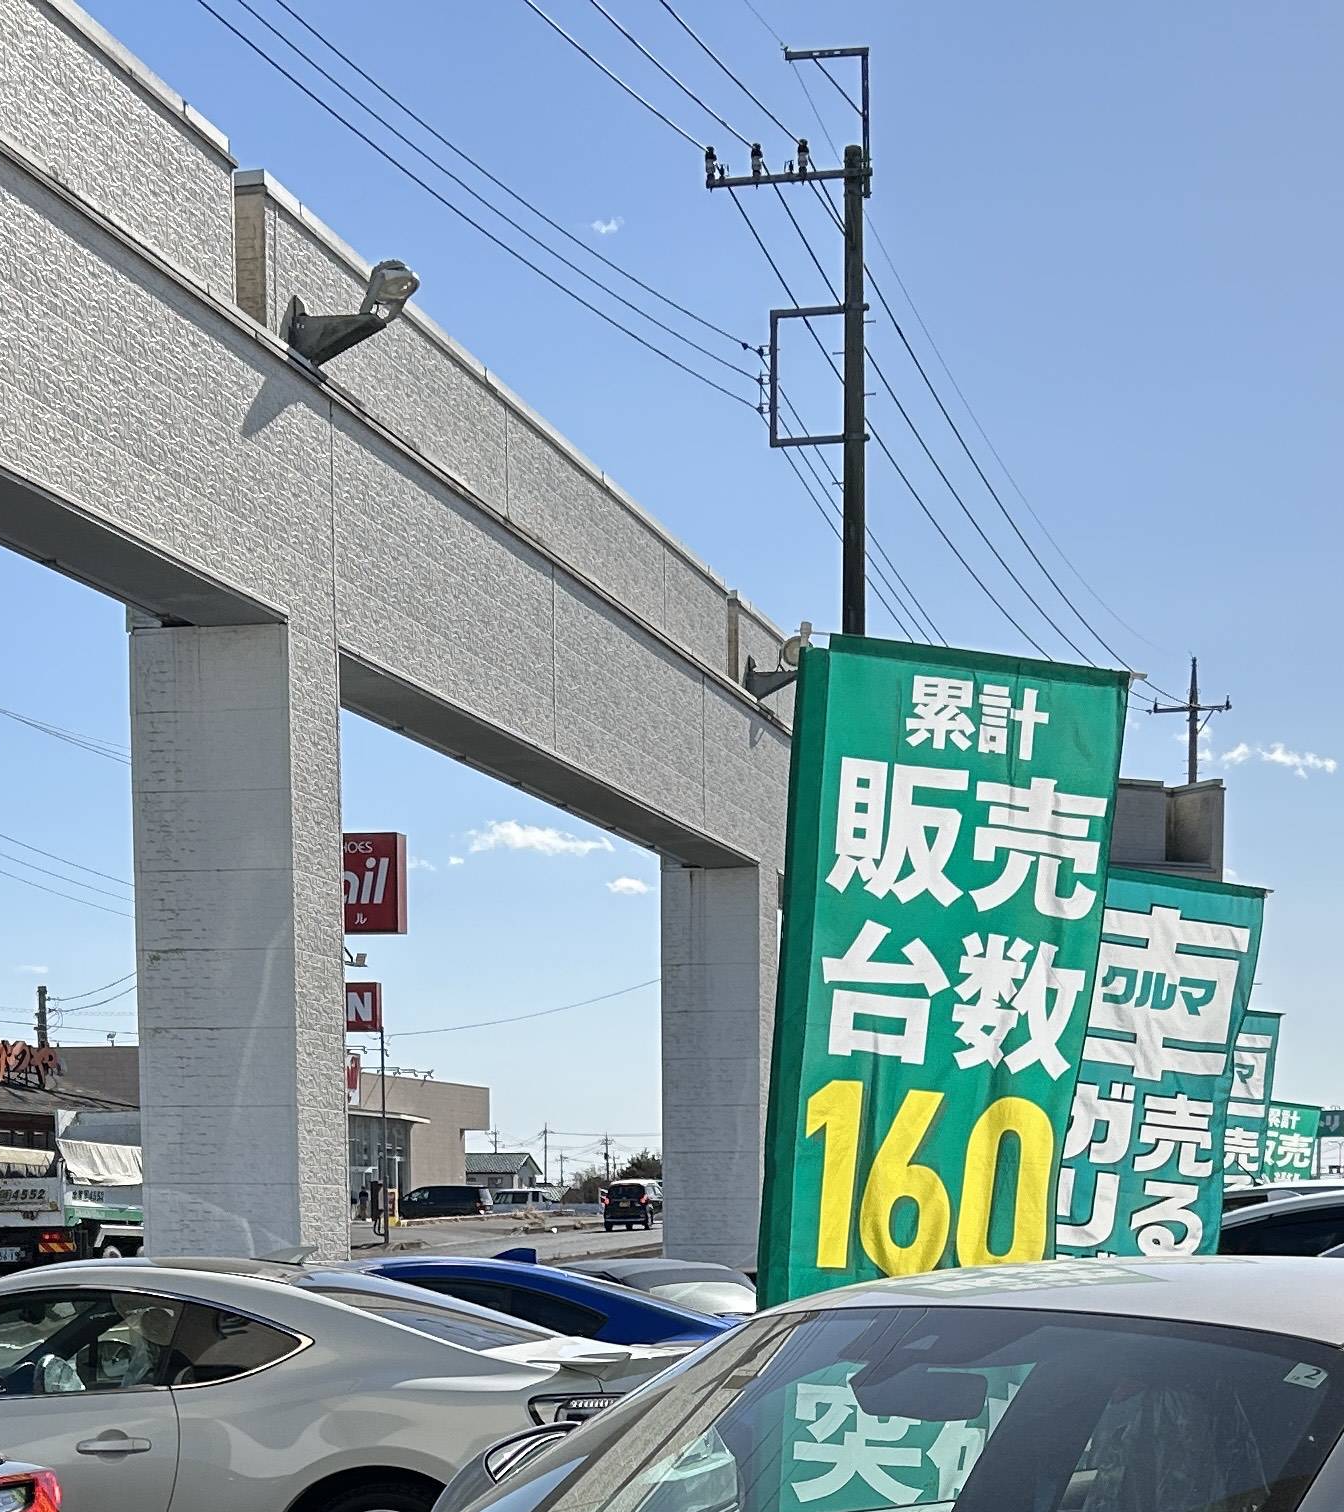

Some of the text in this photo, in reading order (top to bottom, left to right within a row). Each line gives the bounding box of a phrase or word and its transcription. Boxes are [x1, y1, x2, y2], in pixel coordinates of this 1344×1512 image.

[905, 675, 1050, 761] 累計
[825, 756, 1108, 921] 販売
[821, 918, 1086, 1081] 台数
[1101, 966, 1217, 1016] クルマ
[804, 1079, 1055, 1279] 160
[1130, 1092, 1214, 1257] 売る
